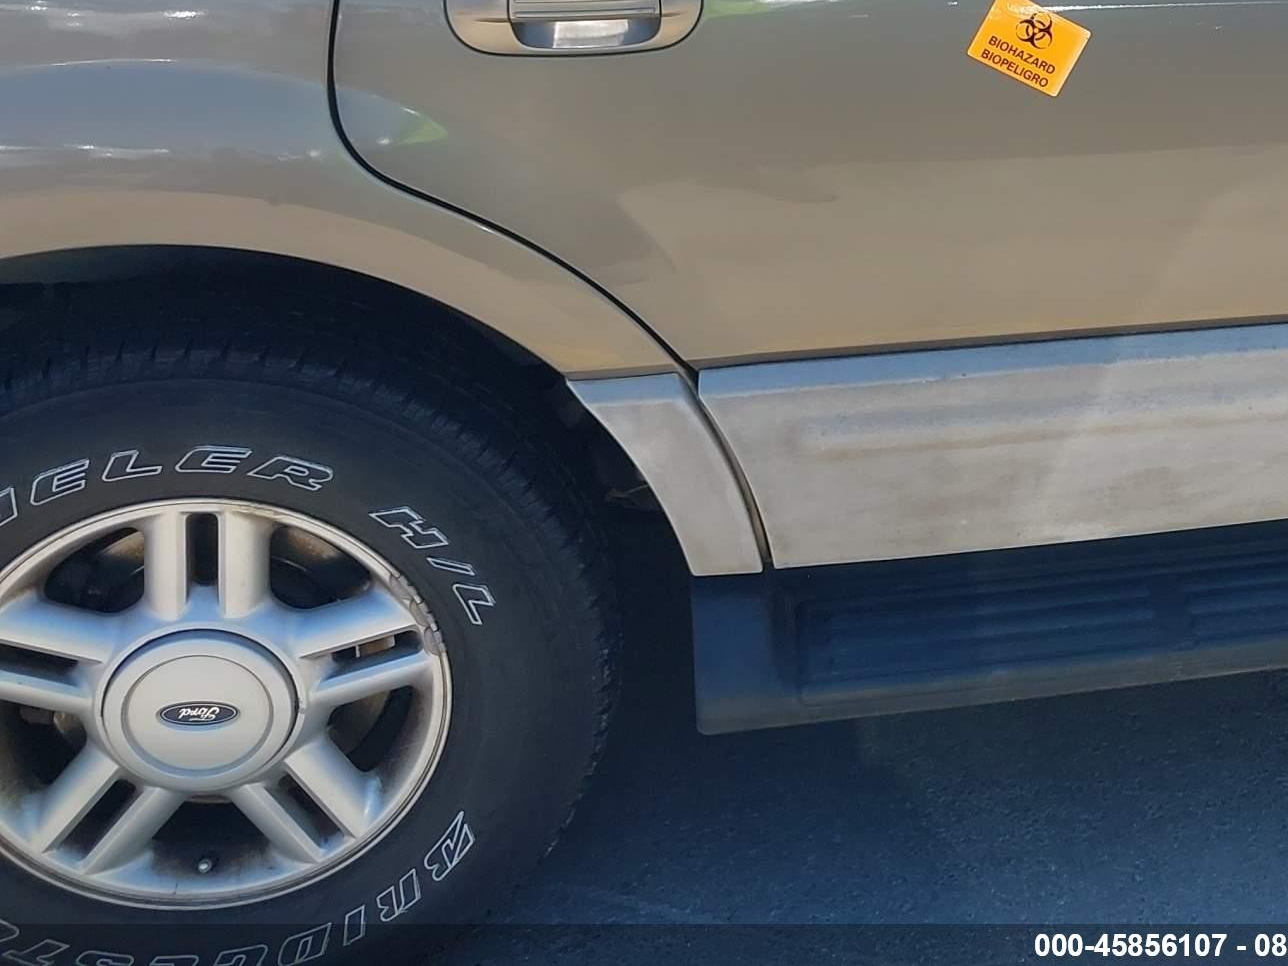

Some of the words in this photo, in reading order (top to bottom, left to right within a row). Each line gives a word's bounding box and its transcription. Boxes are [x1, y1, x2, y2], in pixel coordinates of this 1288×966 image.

[980, 48, 1049, 88] BIOPELIGRO
[987, 35, 1056, 75] BIOHAZARD
[0, 445, 335, 527] ELER
[178, 706, 220, 721] Ford
